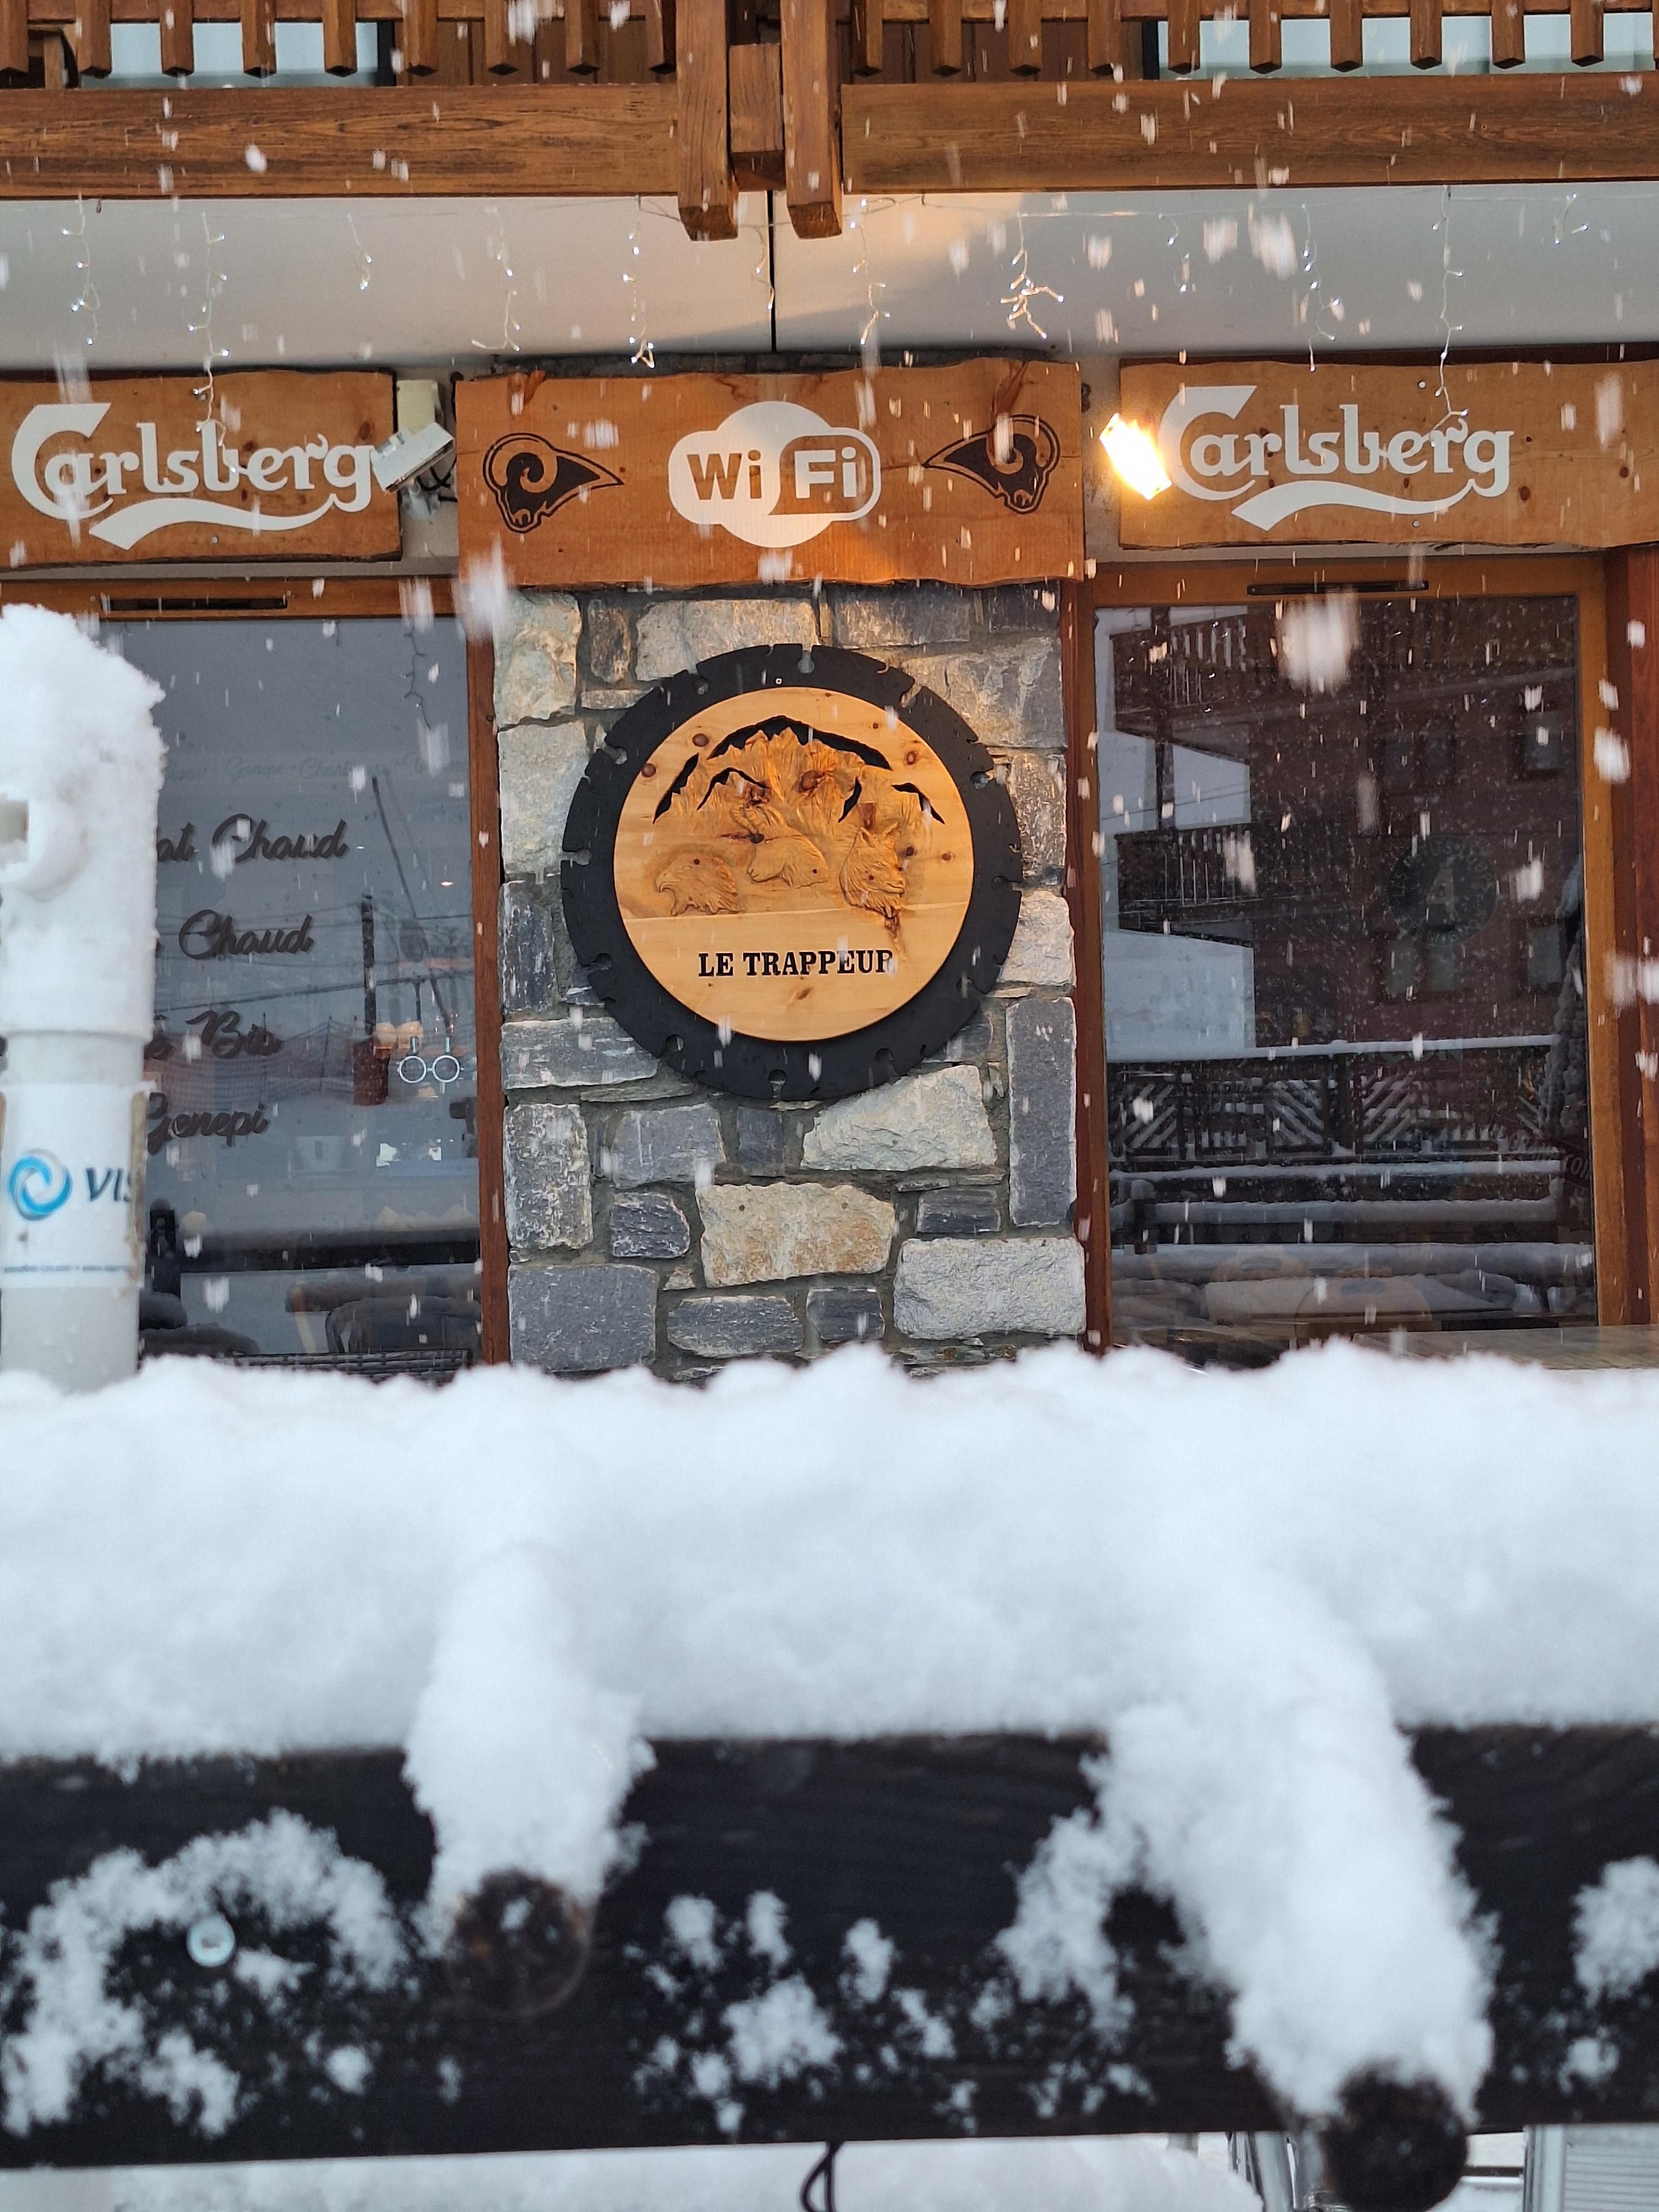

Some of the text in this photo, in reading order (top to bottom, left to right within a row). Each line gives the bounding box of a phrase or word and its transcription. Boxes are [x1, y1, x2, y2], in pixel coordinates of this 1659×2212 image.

[11, 403, 377, 549] Carlsberg
[1159, 385, 1514, 531] Carlsberg
[212, 813, 349, 864] Chaud
[178, 909, 314, 960] Chaud
[698, 949, 895, 976] LE TRAPPEUR
